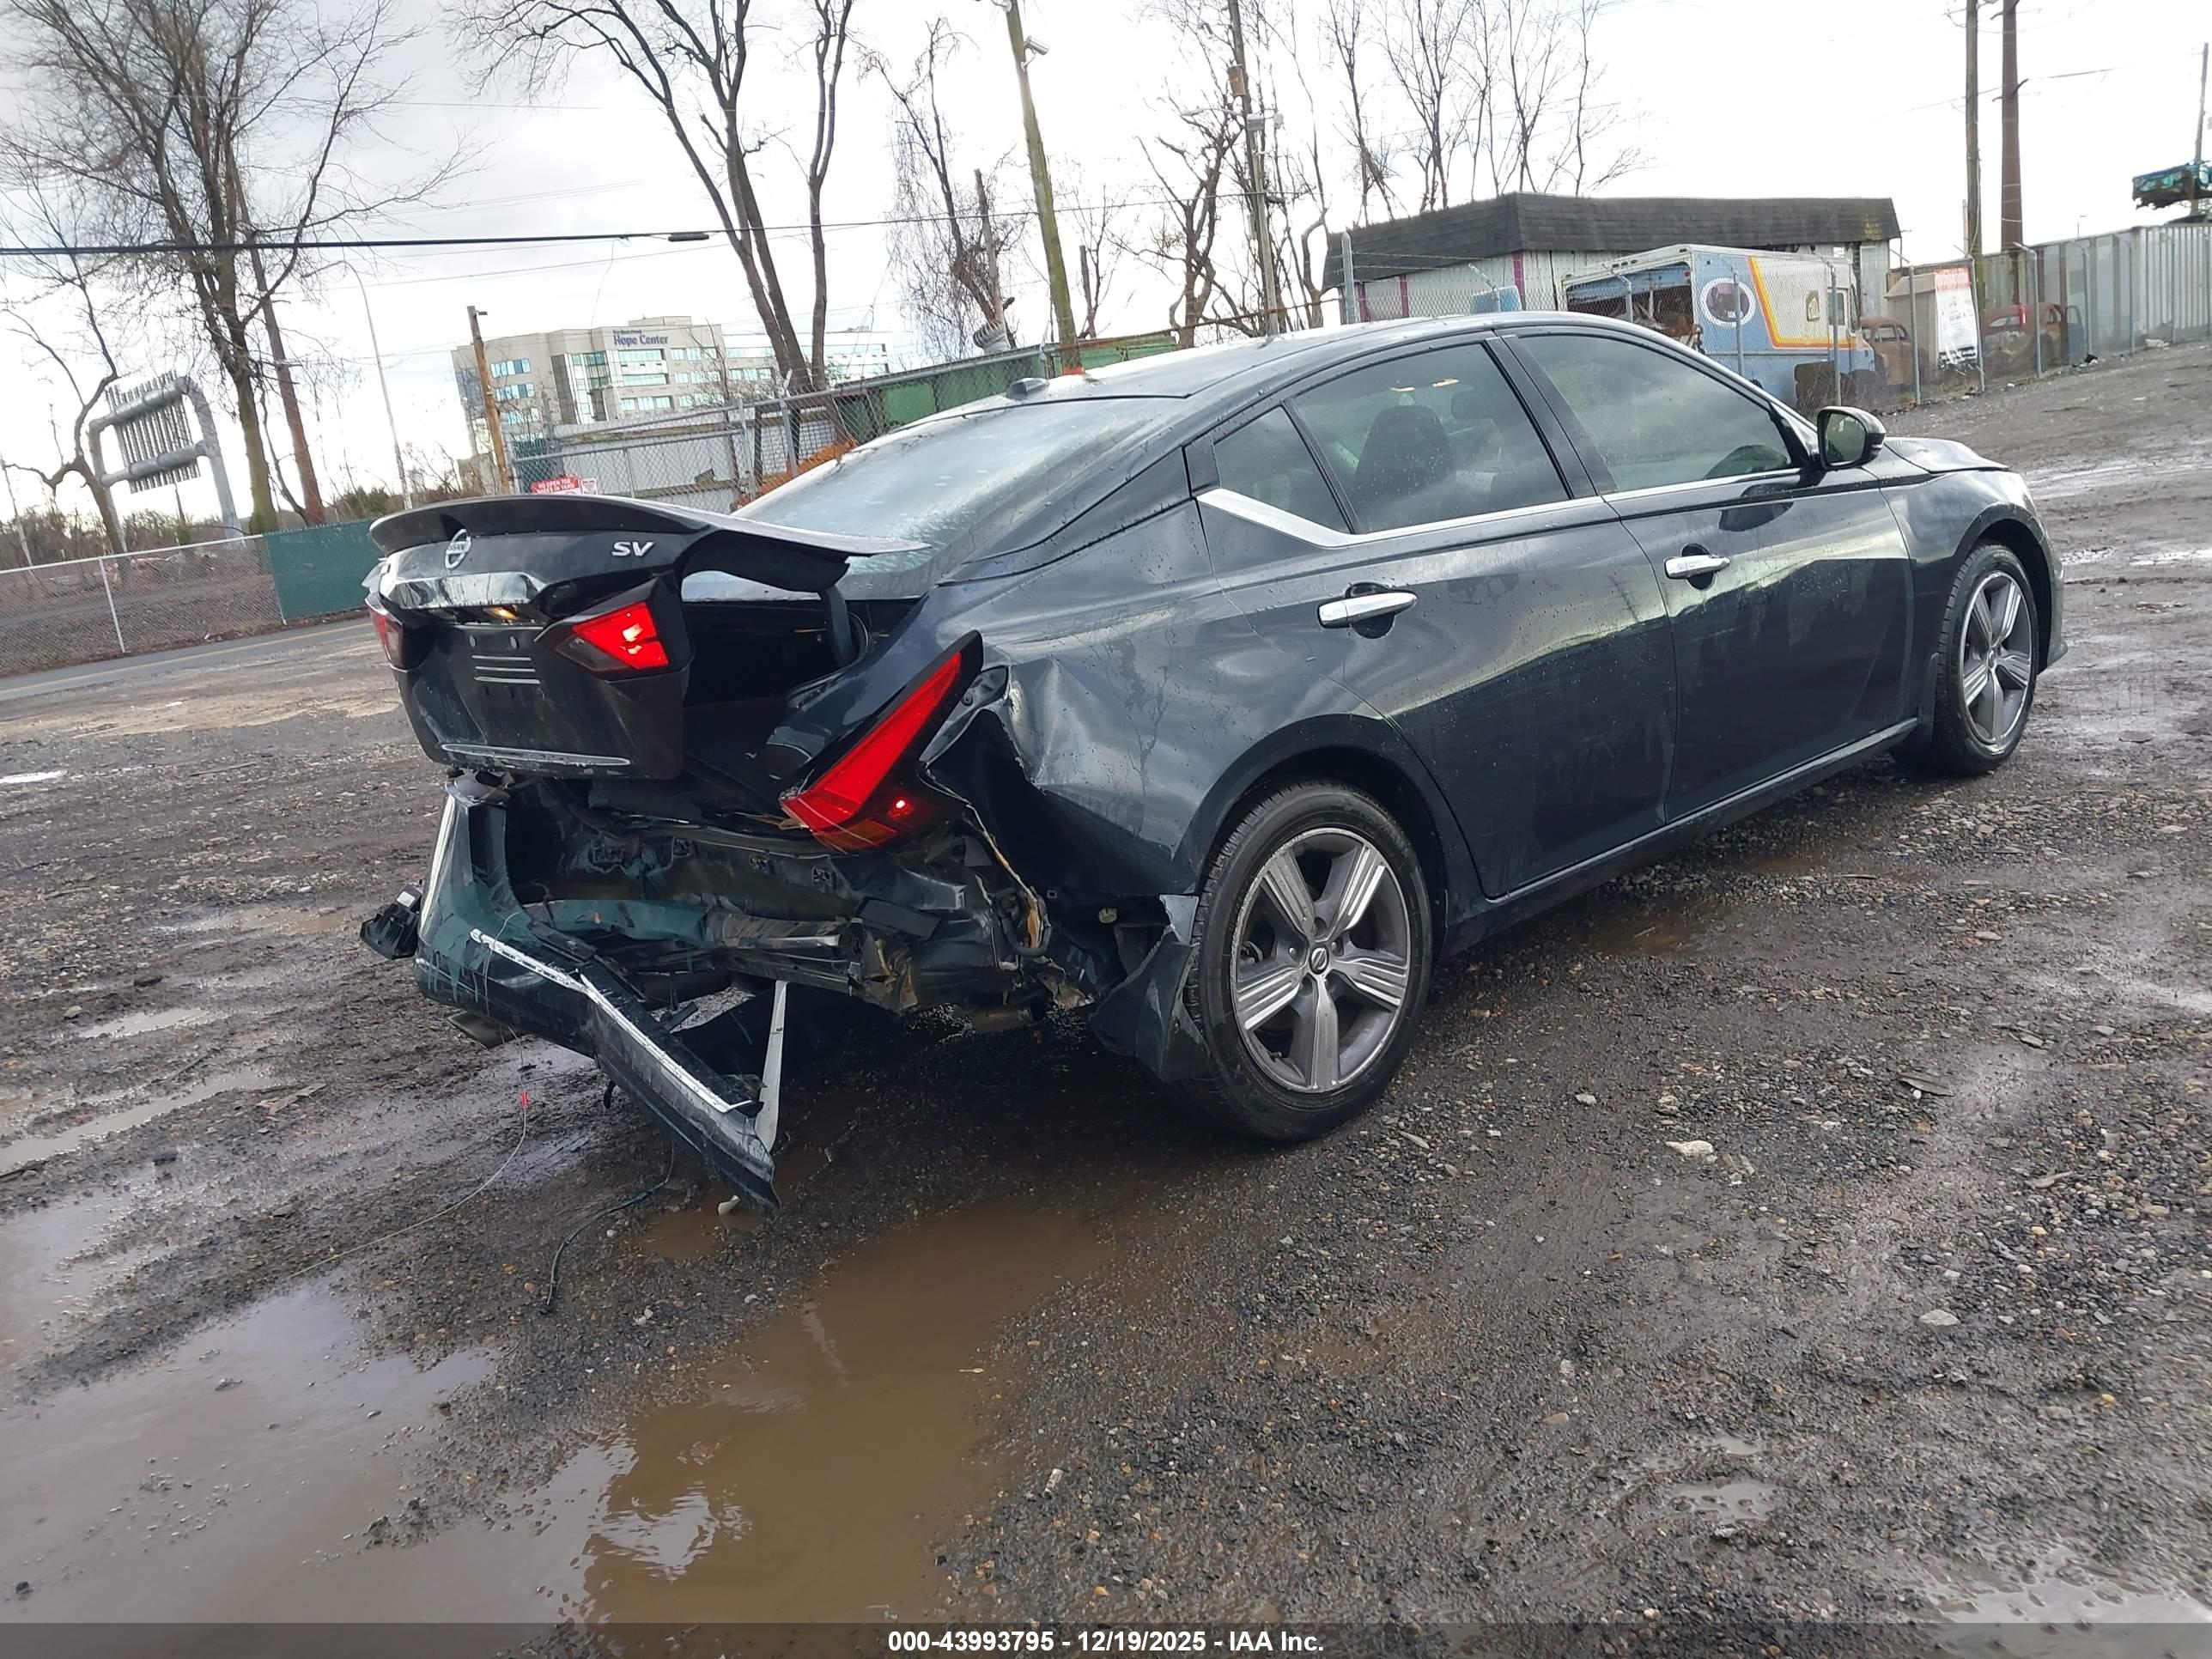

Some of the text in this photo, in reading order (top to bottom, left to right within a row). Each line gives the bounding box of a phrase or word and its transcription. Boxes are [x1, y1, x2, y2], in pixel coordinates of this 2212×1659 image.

[613, 334, 669, 347] Hope Center
[546, 479, 561, 488] OPEN
[611, 541, 655, 556] SV
